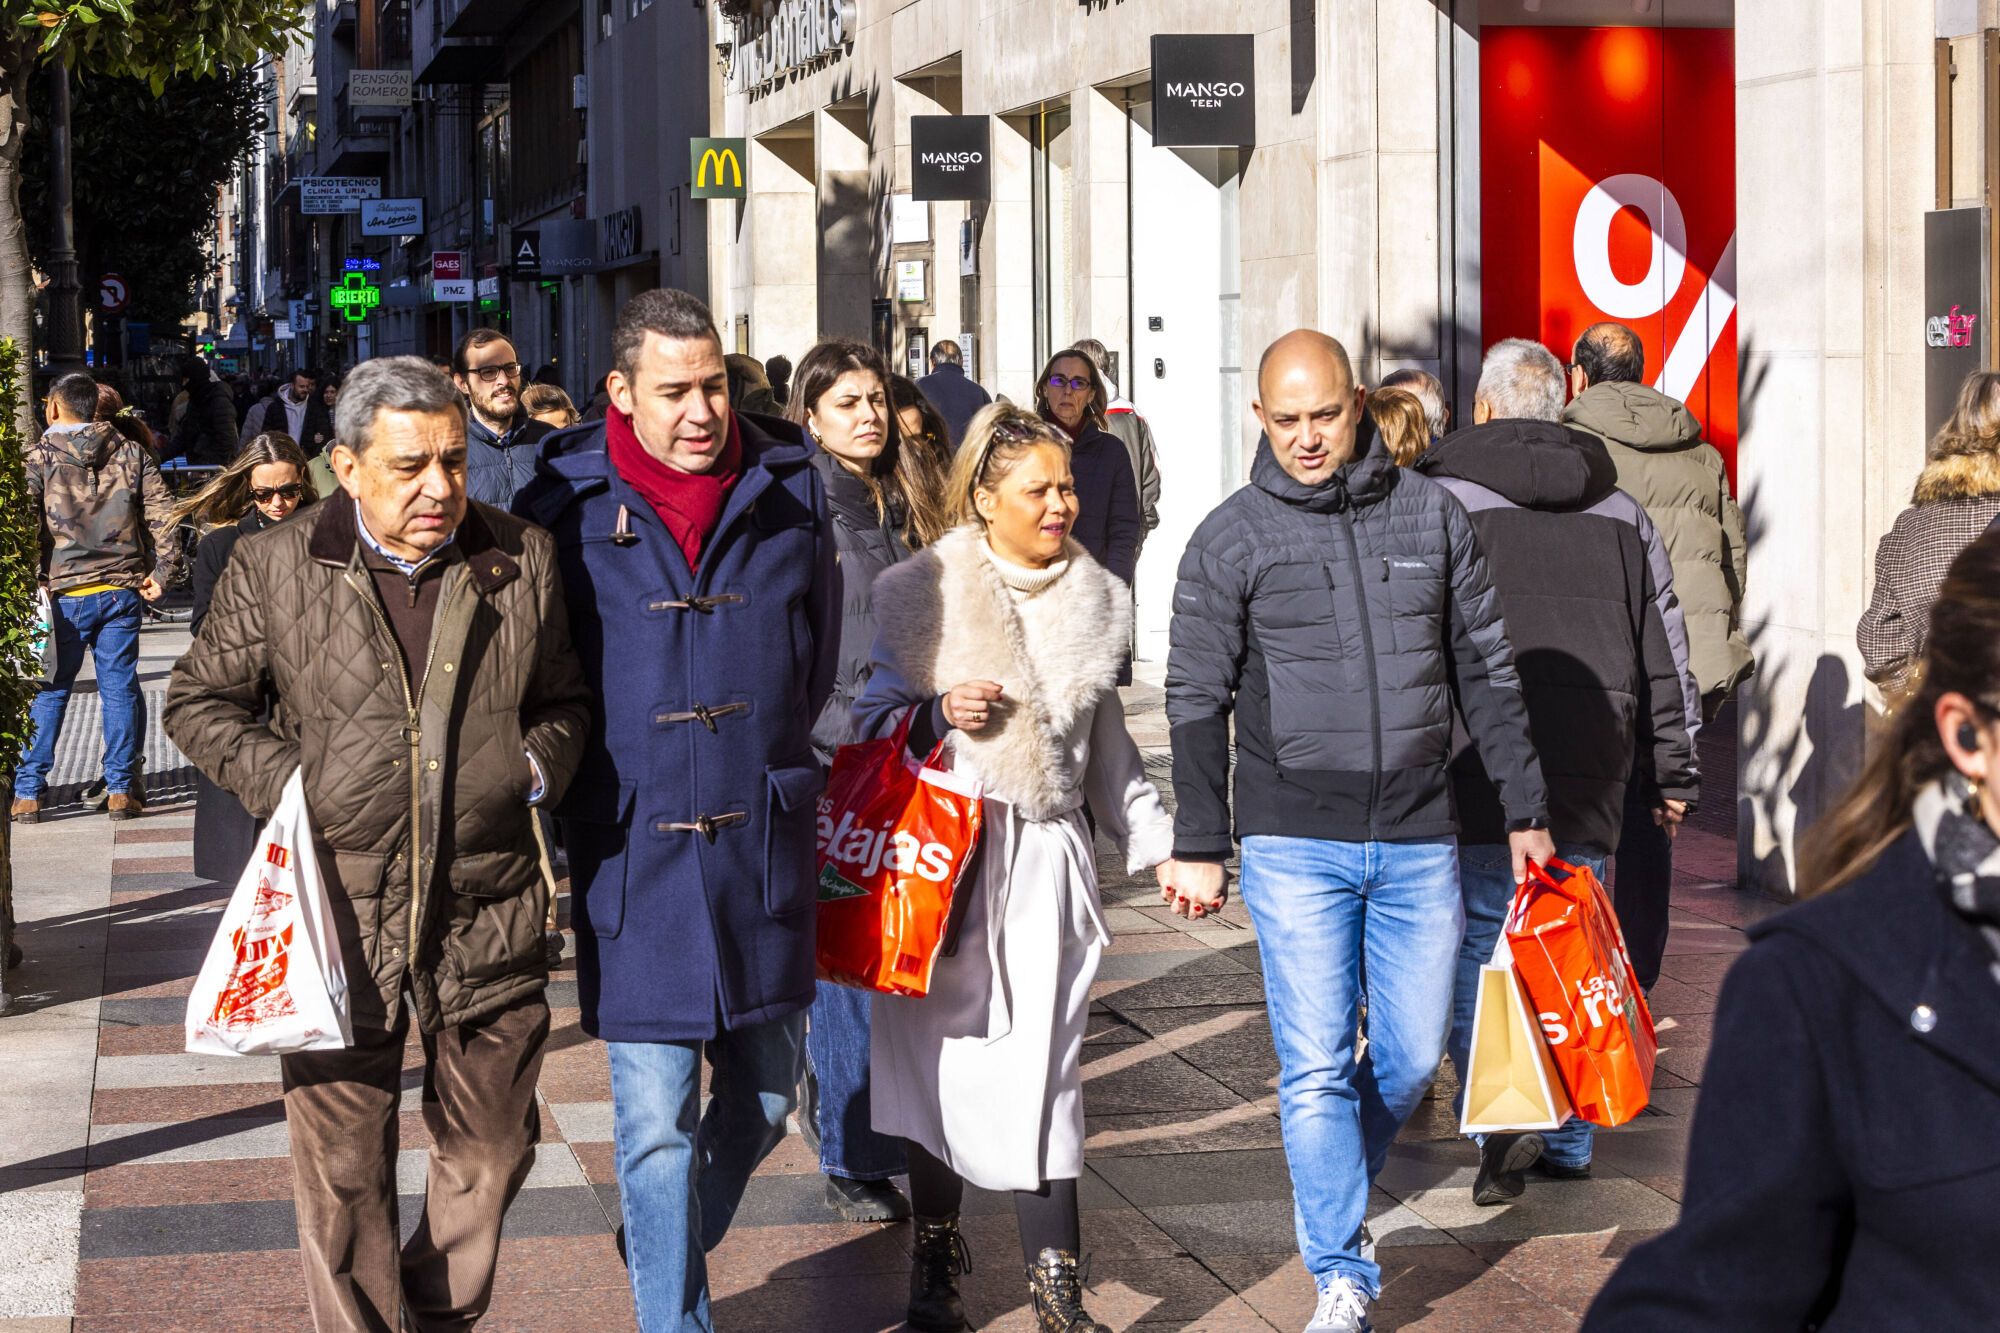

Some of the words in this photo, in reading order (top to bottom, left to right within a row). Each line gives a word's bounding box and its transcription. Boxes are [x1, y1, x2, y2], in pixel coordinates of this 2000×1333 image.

[739, 0, 844, 94] McDonalds
[352, 72, 409, 84] PENSIÓN
[352, 86, 409, 97] ROMERO
[1166, 82, 1245, 97] MANGO
[1190, 99, 1222, 108] TEEN
[921, 152, 983, 164] MANGO
[940, 164, 965, 172] TEEN
[367, 213, 418, 228] Antonio
[603, 207, 639, 262] MANGO
[434, 260, 460, 269] GAES
[546, 258, 592, 267] MANGO
[442, 286, 466, 295] PMZ
